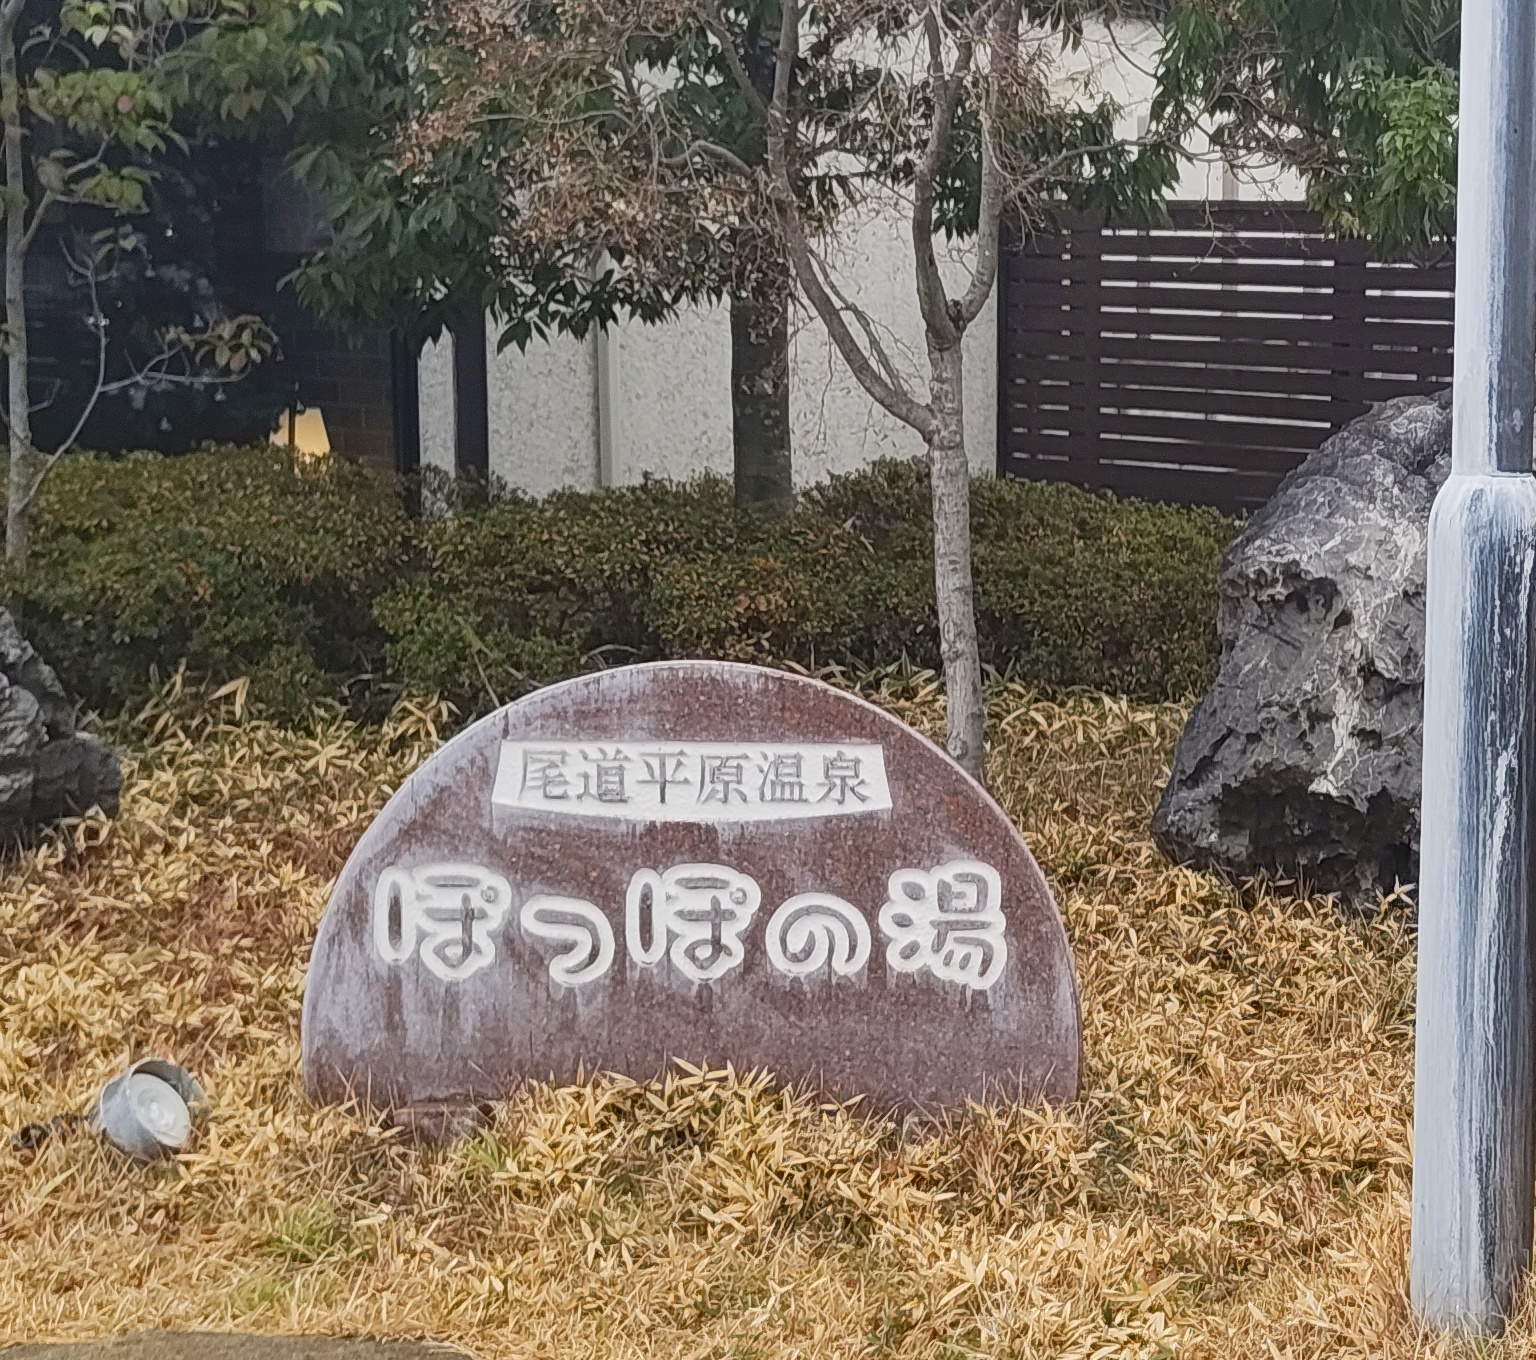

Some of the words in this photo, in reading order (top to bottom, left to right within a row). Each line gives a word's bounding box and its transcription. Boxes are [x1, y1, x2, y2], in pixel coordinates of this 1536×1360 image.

[518, 746, 871, 805] 尾道平原温泉
[375, 861, 1007, 989] ぽっぽの湯
